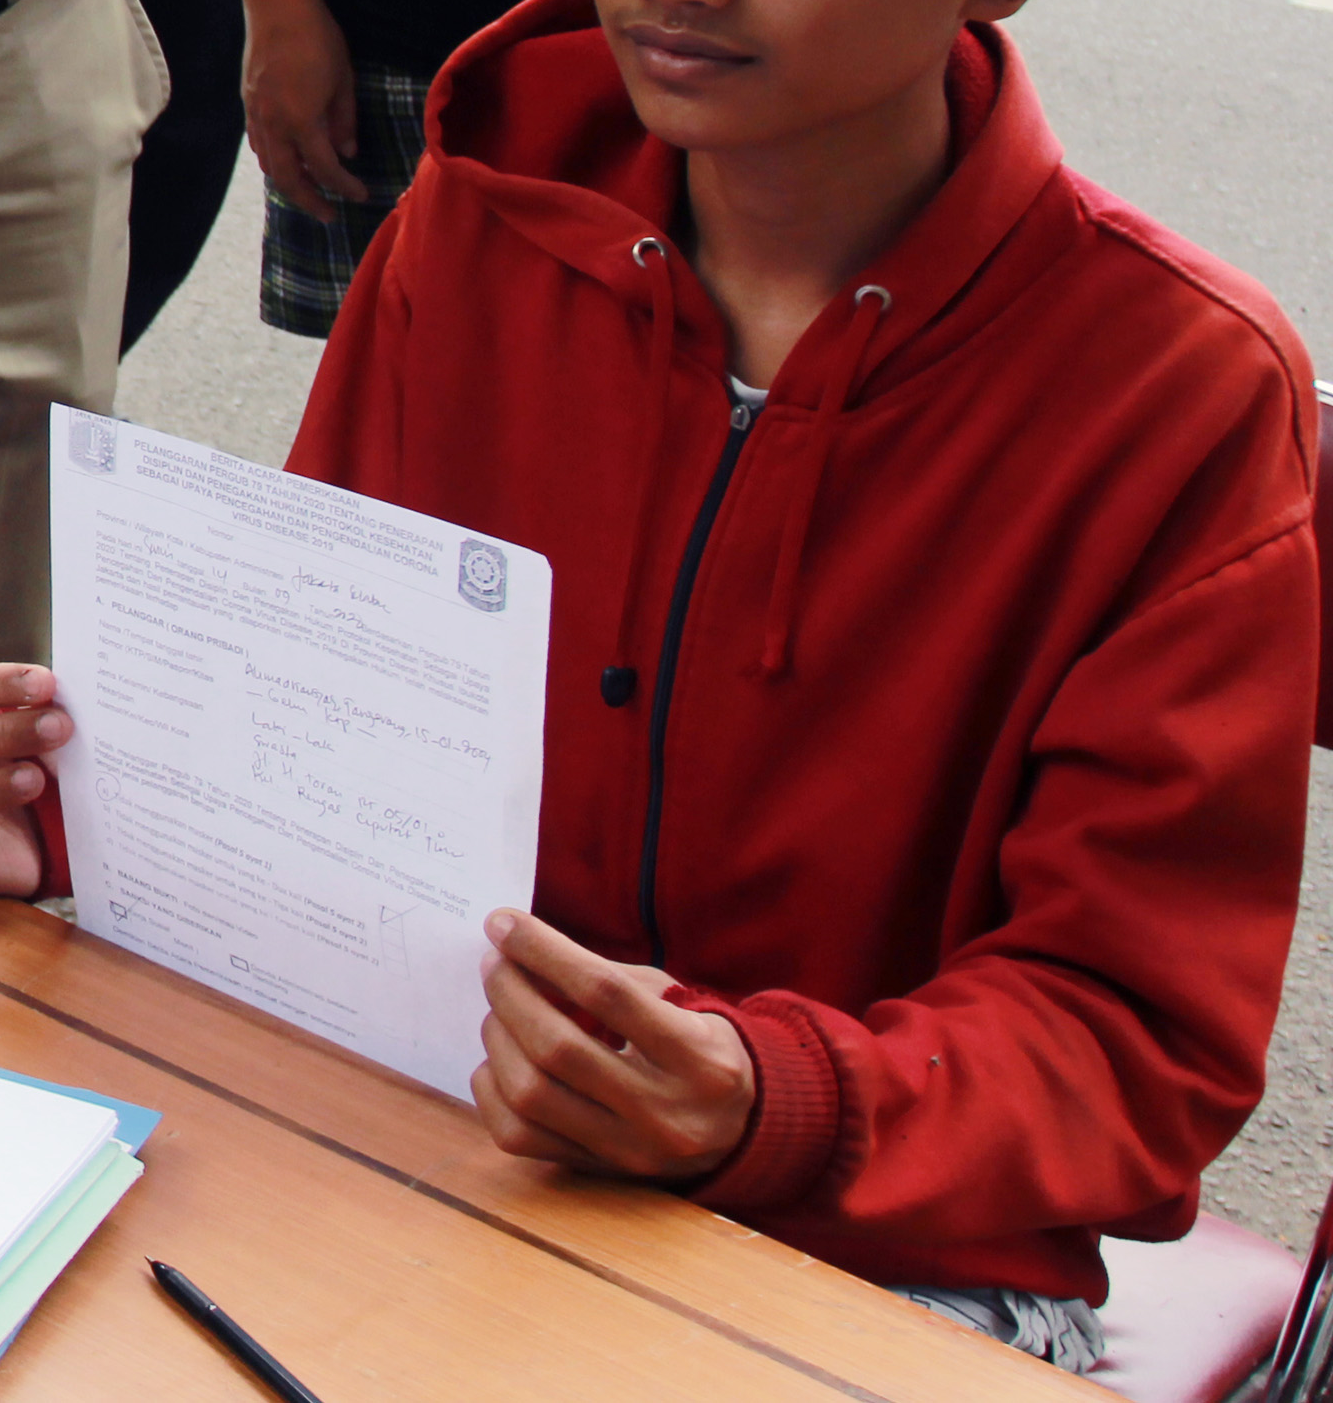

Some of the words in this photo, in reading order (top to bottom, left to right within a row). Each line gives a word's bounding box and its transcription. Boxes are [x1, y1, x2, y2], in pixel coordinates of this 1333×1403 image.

[134, 439, 206, 471] PELANGGARAN
[209, 465, 248, 486] PERGUB
[252, 480, 262, 490] 79
[266, 484, 300, 502] TAHUN
[304, 497, 325, 510] 2020
[328, 504, 377, 528] TENTANG
[379, 522, 443, 551] PENERAPAN
[136, 465, 179, 486] SEBAGAI
[182, 480, 212, 498] UPAYA
[215, 493, 283, 523] PENCEGAHAN
[287, 516, 309, 531] DAN
[311, 525, 390, 559] PENGENDALIAN
[392, 553, 439, 577] CORONA
[142, 455, 182, 475] DISIPLIN
[185, 469, 204, 483] DAN
[207, 477, 266, 504] PENEGAKAN
[270, 499, 307, 517] HUKUM
[310, 512, 366, 538] PROTOKOL
[369, 533, 432, 561] KESEHATAN
[211, 453, 243, 471] BERITA
[247, 466, 282, 484] ACARA
[286, 478, 359, 509] PEMERIKSAAN
[232, 511, 261, 527] VIRUS
[265, 522, 309, 543] DISEASE
[312, 537, 333, 551] 2019
[111, 602, 164, 628] PELANGGAR
